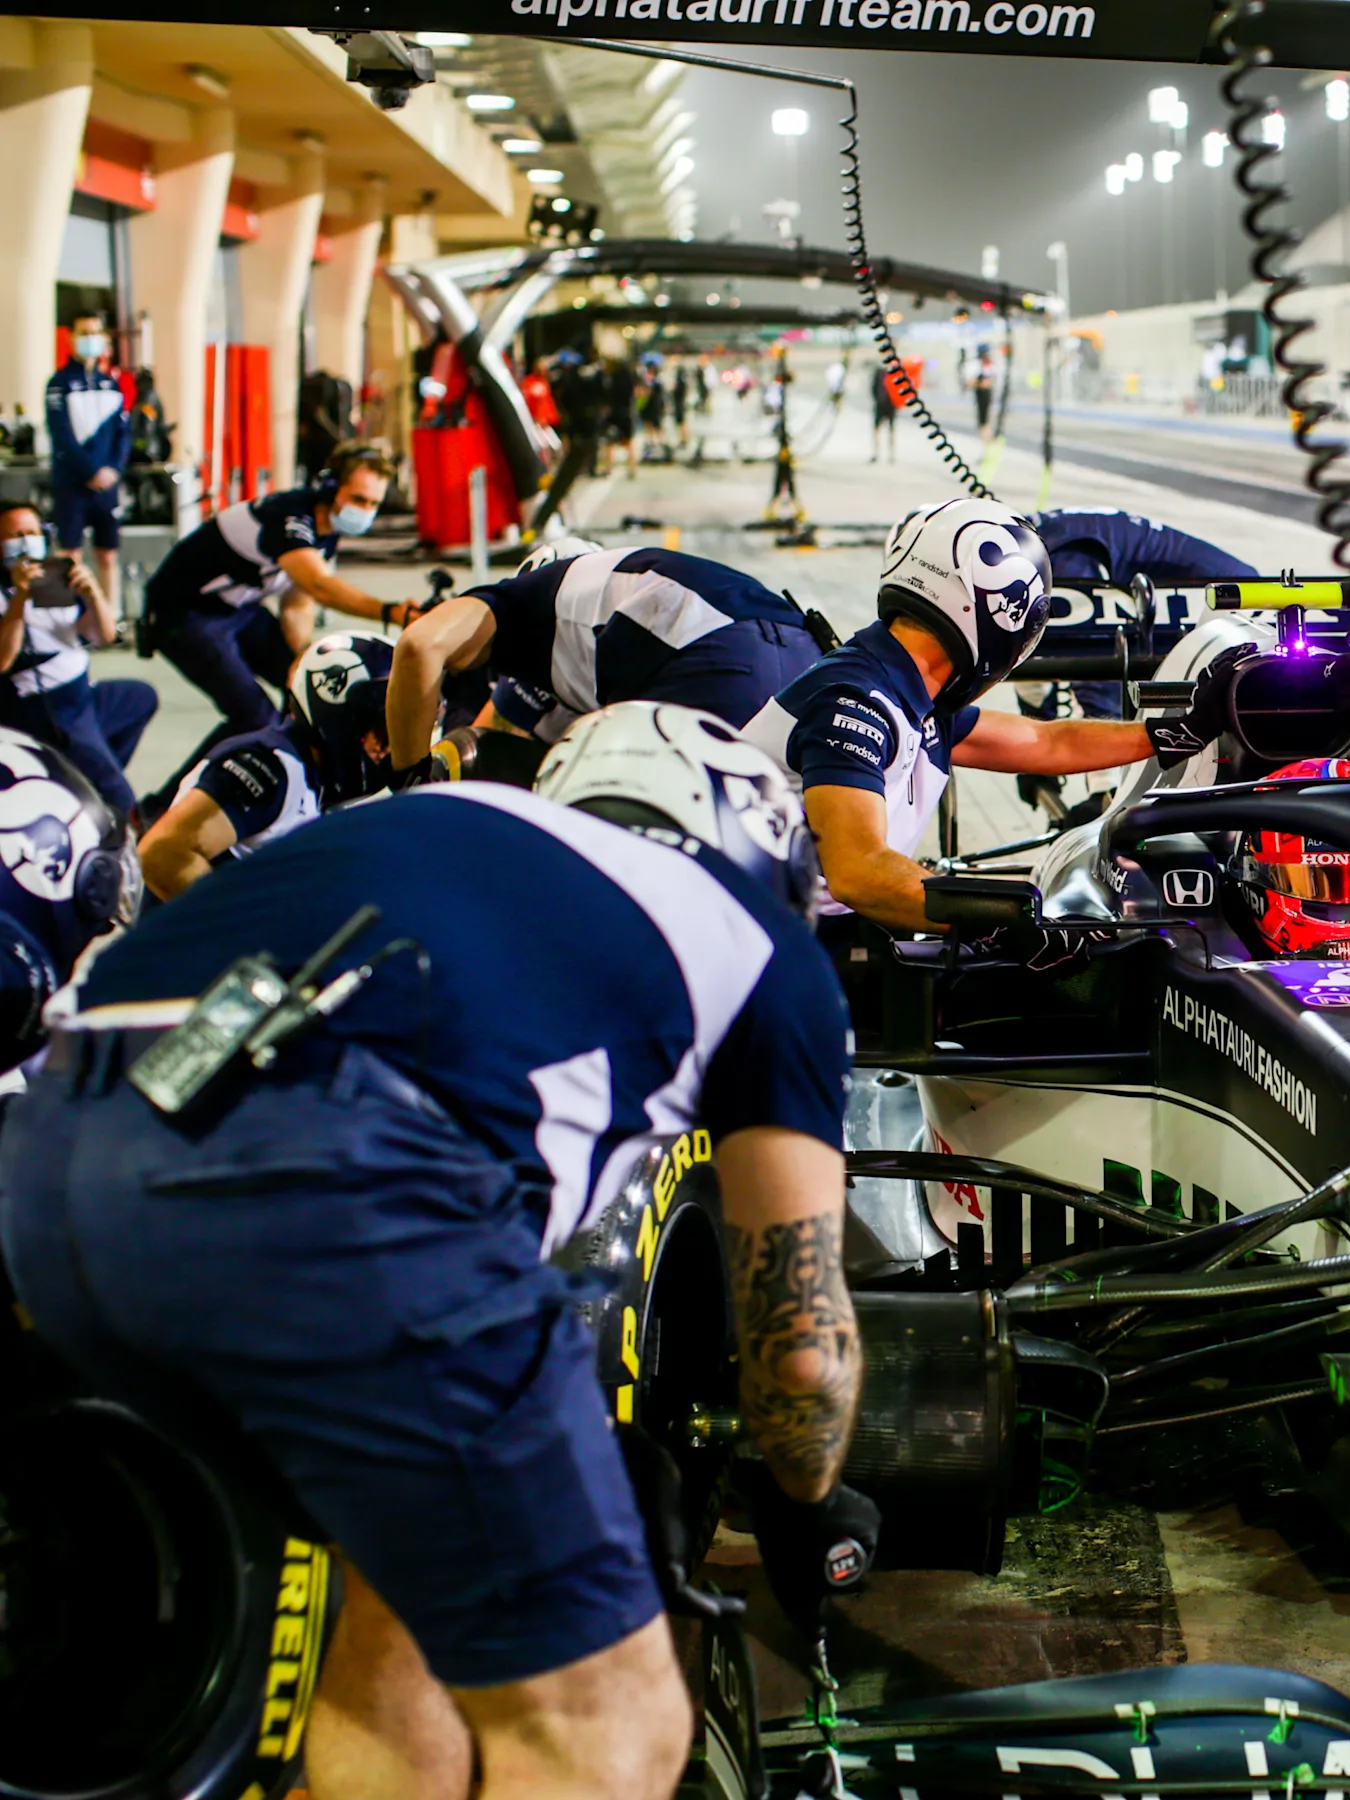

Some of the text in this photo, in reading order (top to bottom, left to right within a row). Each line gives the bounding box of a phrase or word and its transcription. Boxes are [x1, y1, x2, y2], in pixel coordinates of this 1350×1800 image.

[918, 559, 950, 578] randstad
[832, 713, 885, 746] PIRELLI
[842, 741, 882, 766] randstad
[1162, 985, 1317, 1136] ALPHATAURI.FASHION
[255, 1535, 330, 1764] IRELLI
